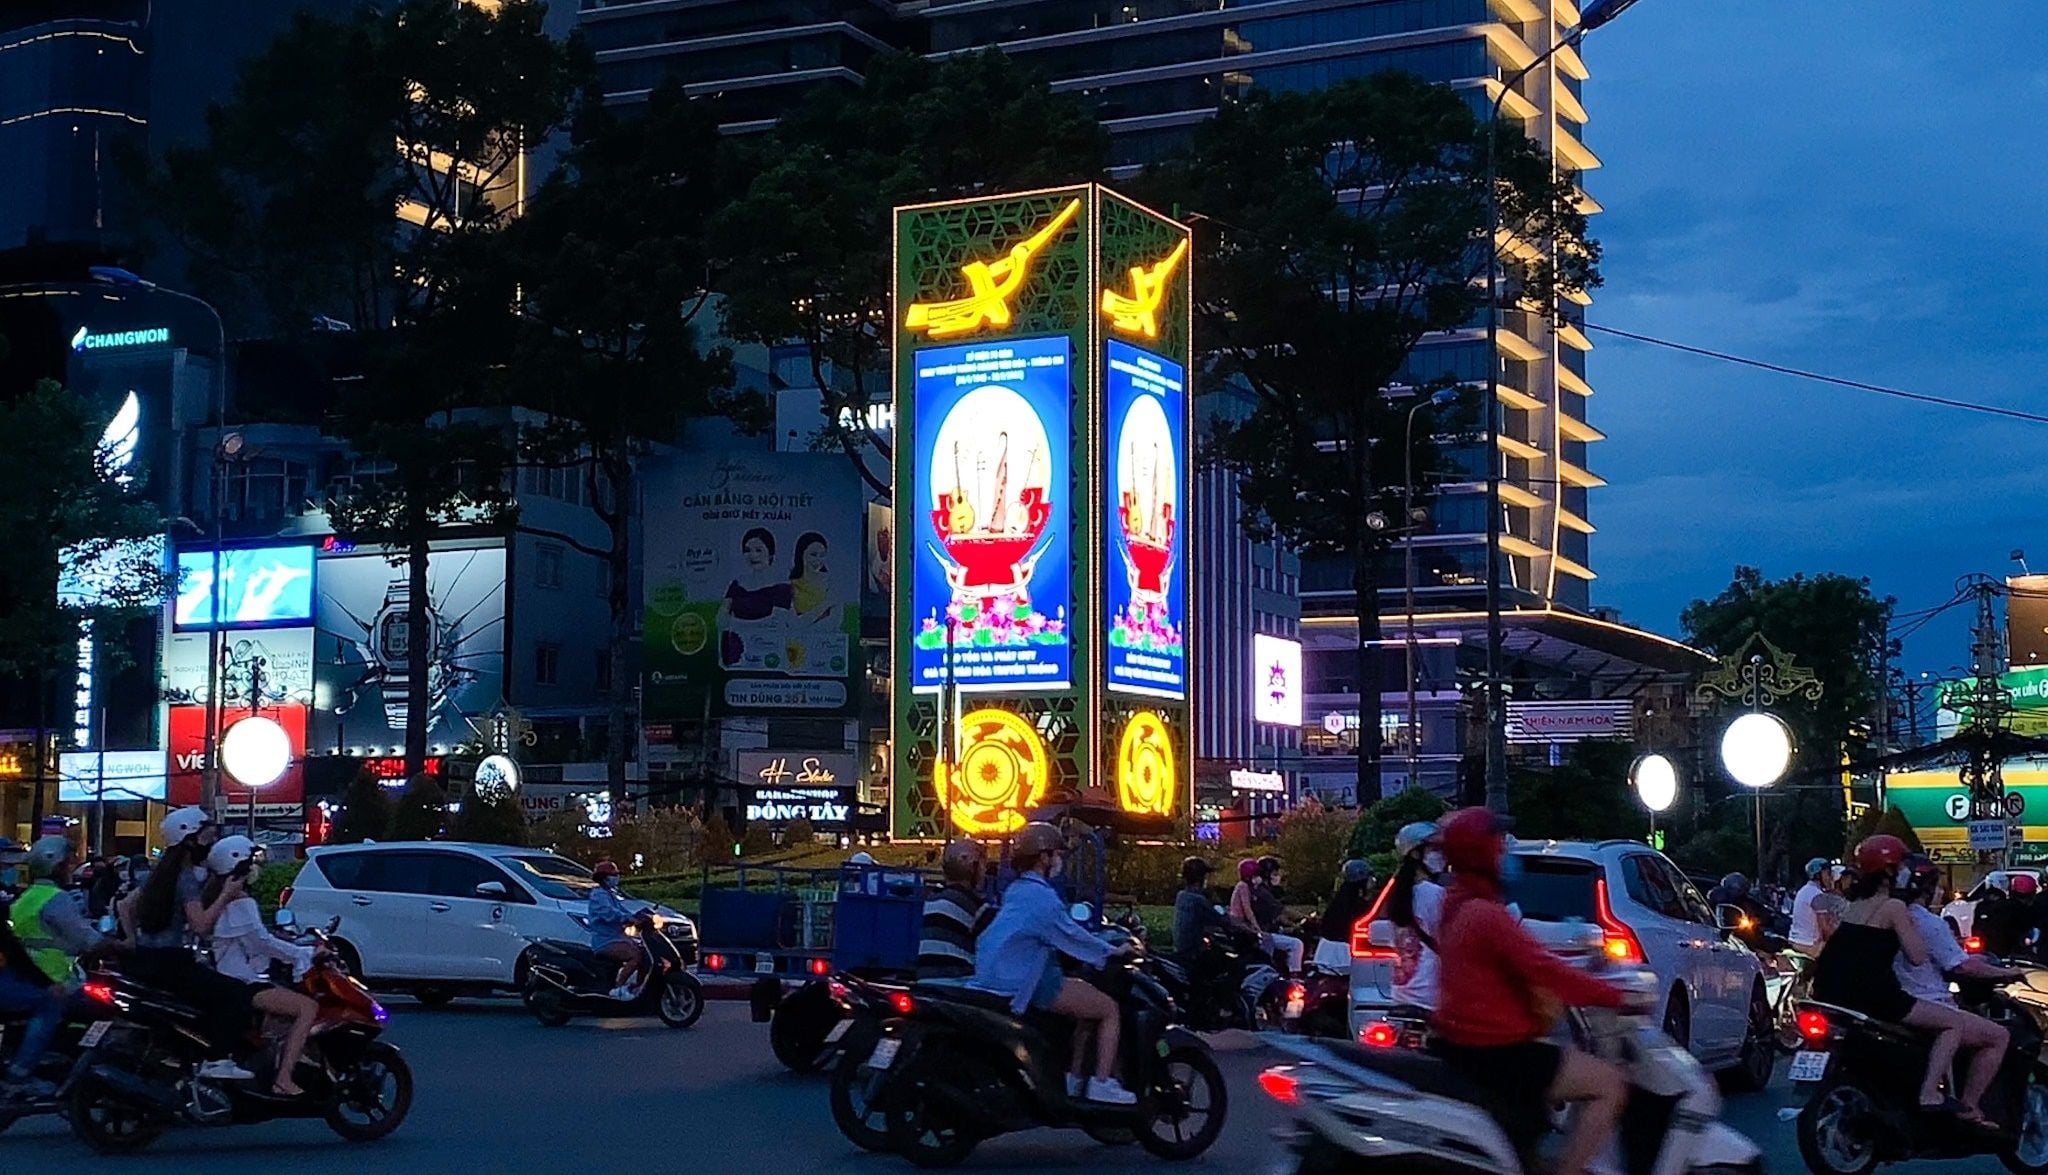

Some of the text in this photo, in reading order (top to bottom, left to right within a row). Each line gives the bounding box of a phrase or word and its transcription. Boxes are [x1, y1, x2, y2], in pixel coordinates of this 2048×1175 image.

[85, 328, 168, 348] CHANGWON
[730, 693, 747, 703] TIN
[1558, 716, 1582, 725] NAM
[809, 801, 849, 820] TÂY
